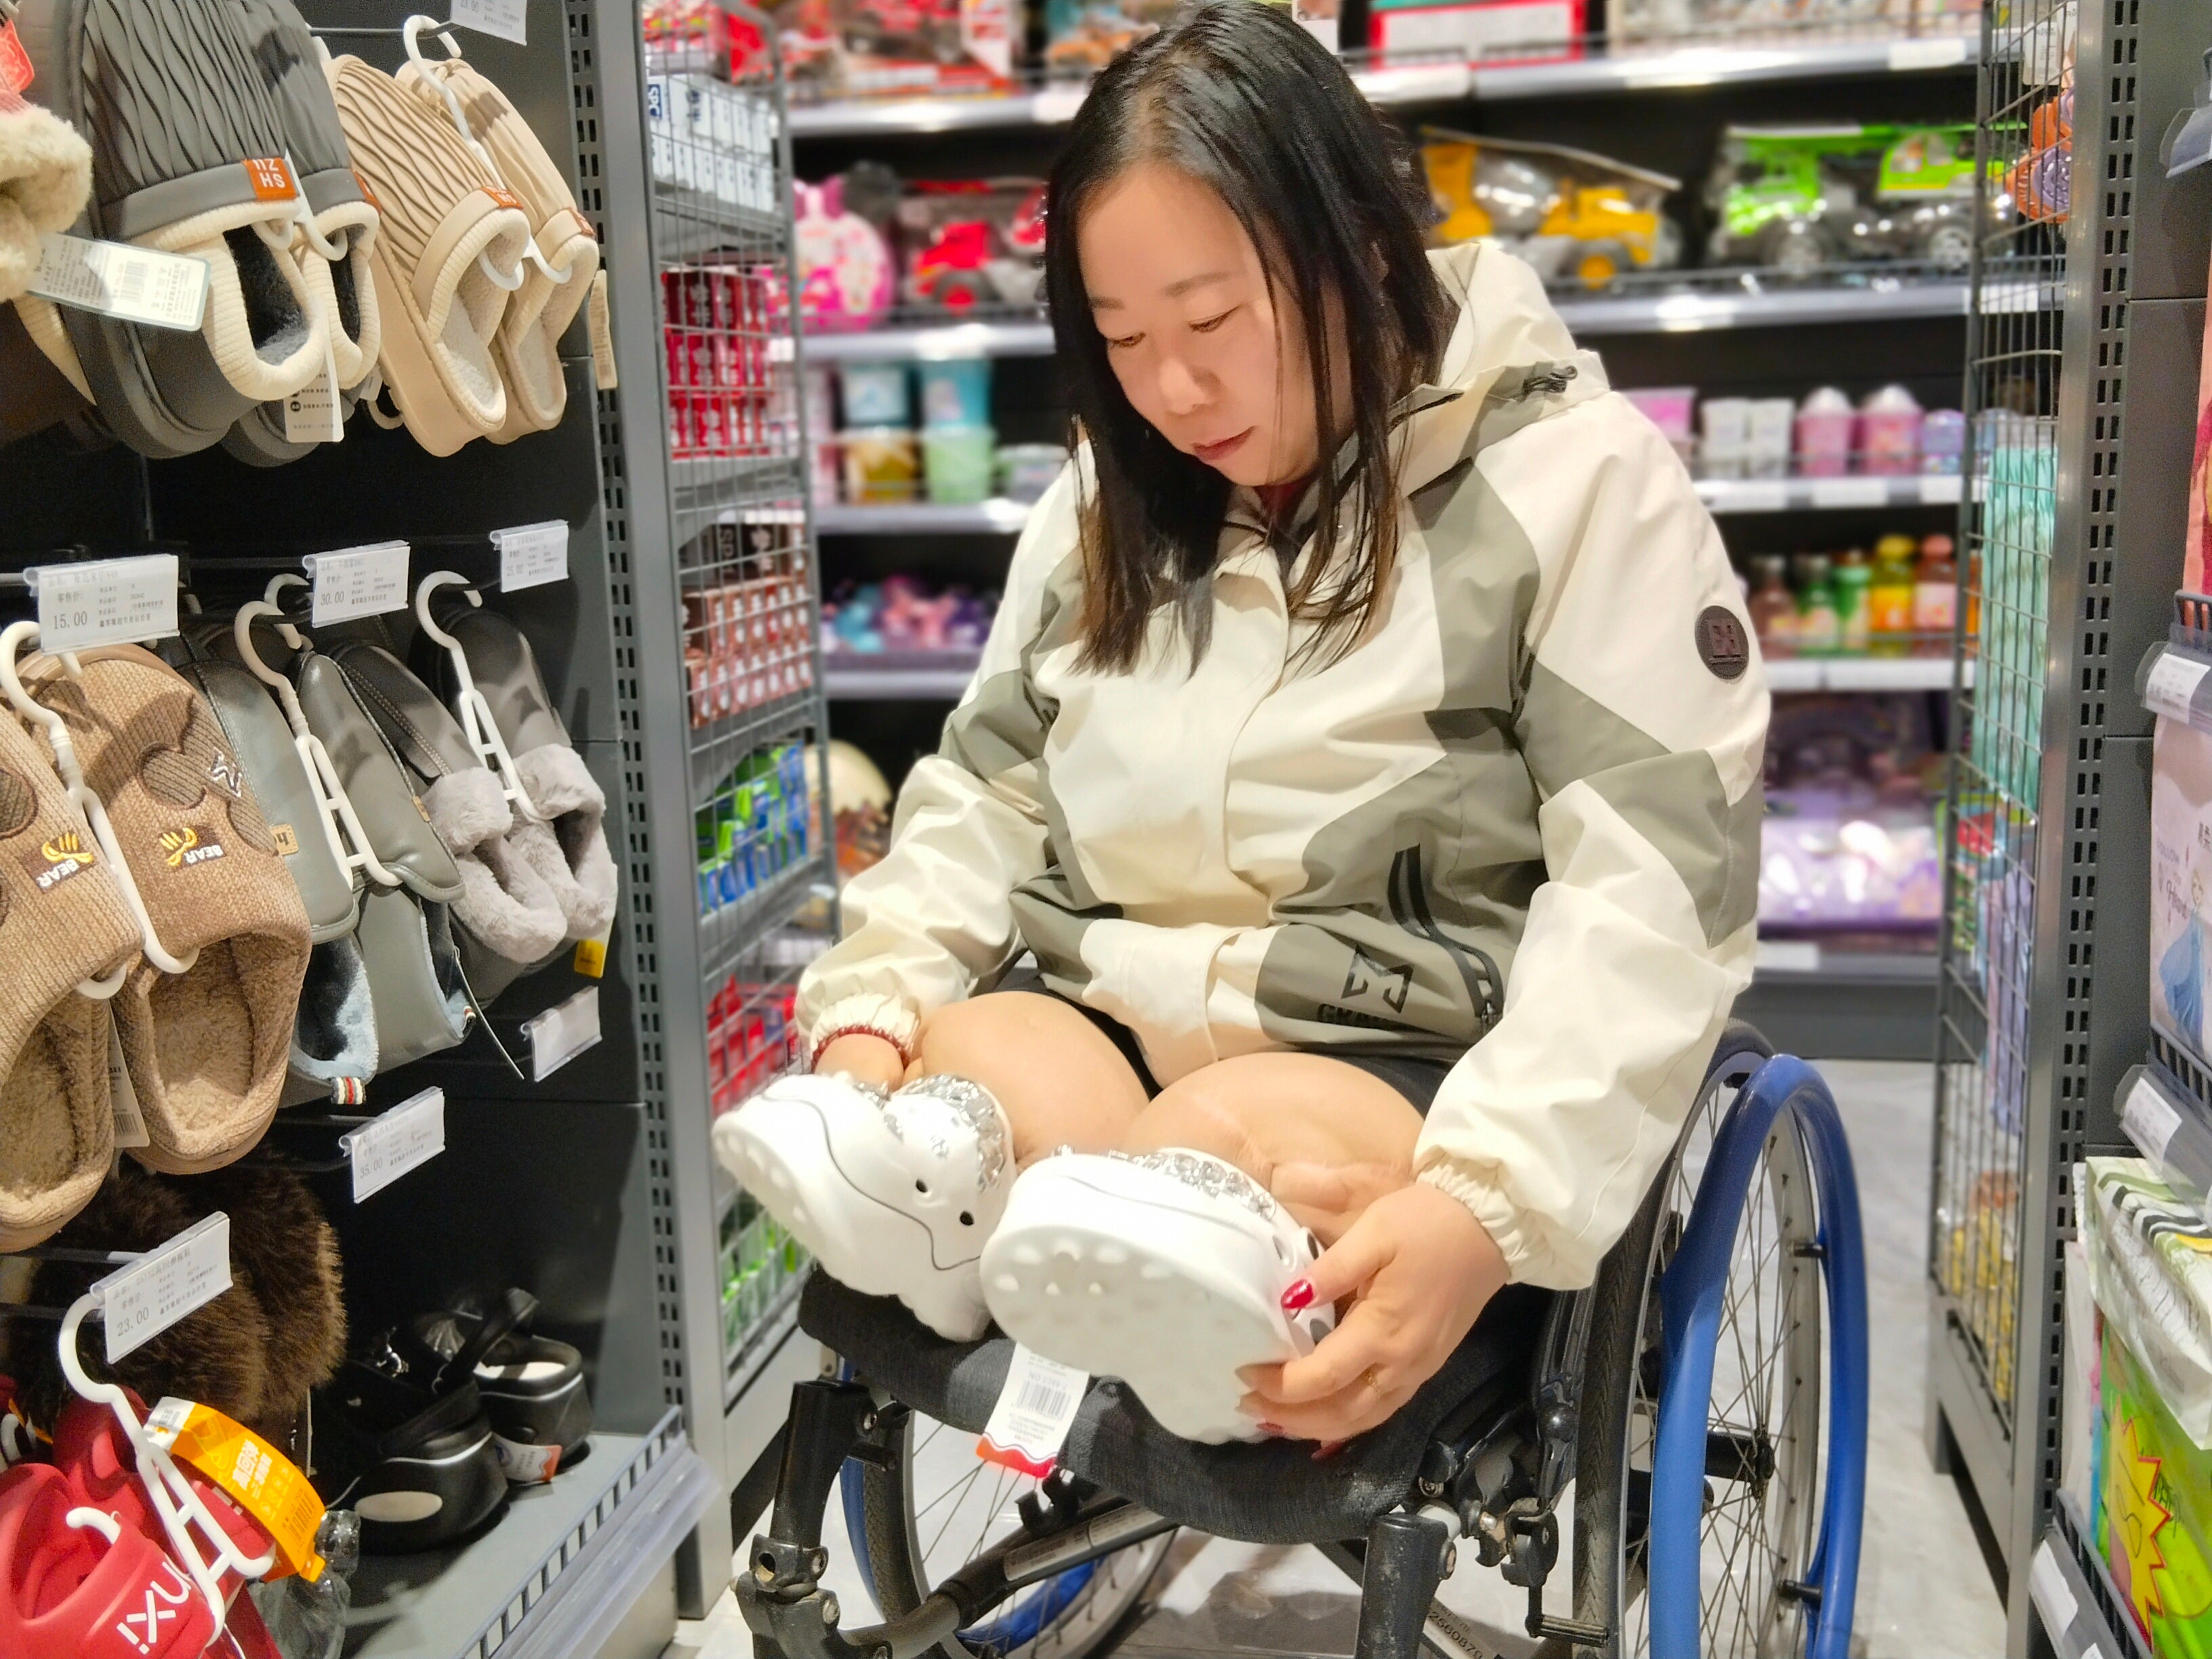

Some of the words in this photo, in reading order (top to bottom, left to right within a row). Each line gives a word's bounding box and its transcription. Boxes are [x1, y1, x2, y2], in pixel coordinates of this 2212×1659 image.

[259, 172, 285, 188] HS
[320, 590, 345, 607] 30.00
[54, 611, 88, 630] 15.00
[183, 844, 224, 864] BEAR
[36, 858, 79, 888] BEAR
[359, 1157, 384, 1179] 35.00
[117, 1307, 150, 1337] 23.00
